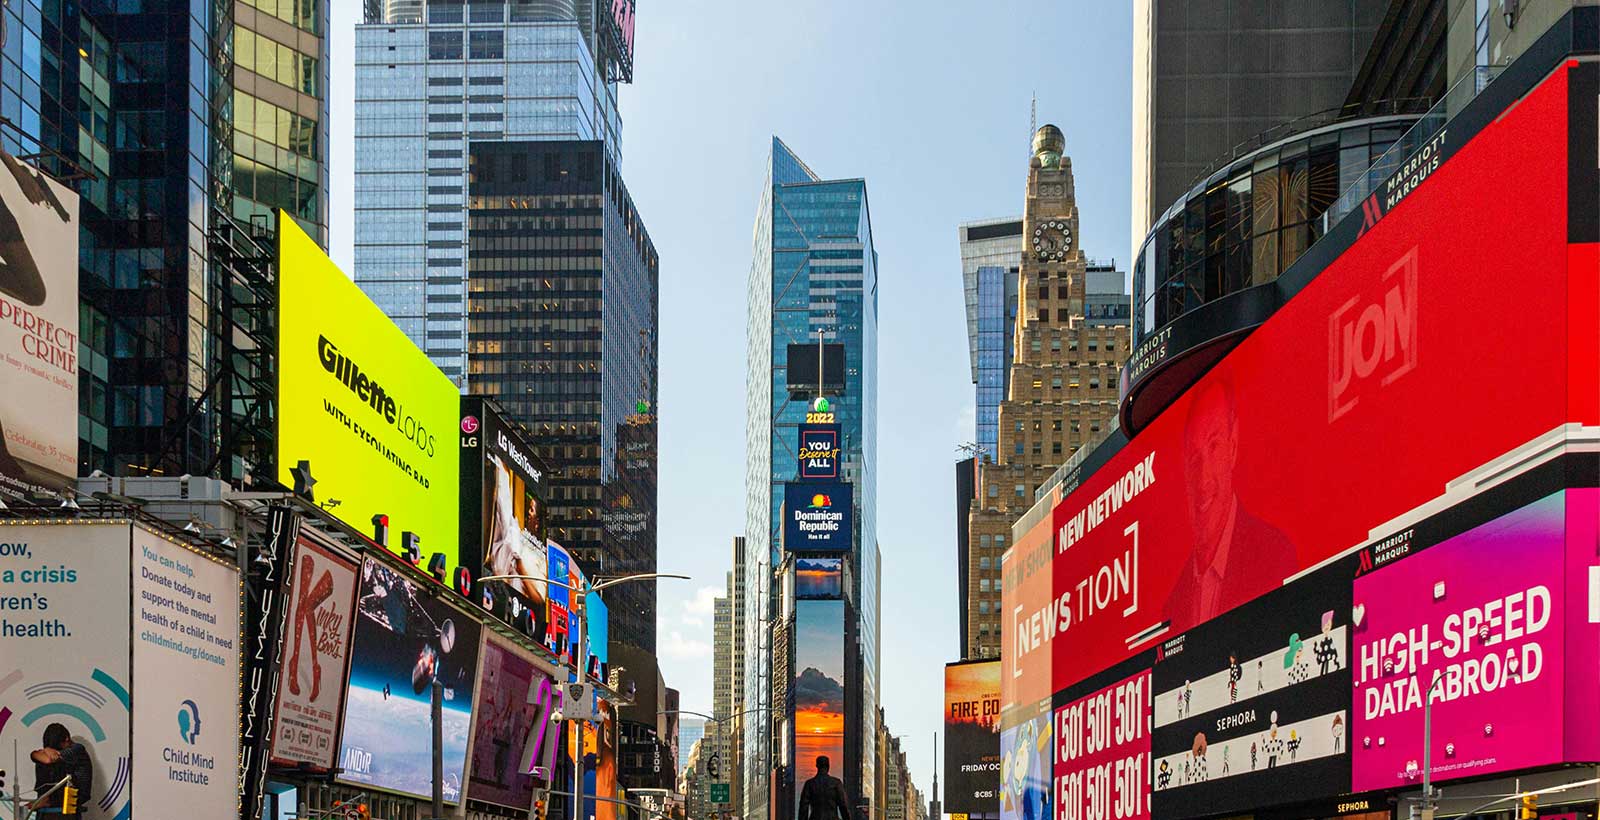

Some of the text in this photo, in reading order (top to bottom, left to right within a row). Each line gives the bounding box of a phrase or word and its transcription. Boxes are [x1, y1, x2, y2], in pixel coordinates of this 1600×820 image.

[1387, 129, 1447, 193] MARRIOTT
[1387, 156, 1438, 210] MARQUIS
[0, 298, 76, 353] PERFECT
[22, 334, 76, 374] CRIME
[1131, 327, 1172, 368] MARRIOTT
[1130, 346, 1165, 383] MARQUIS
[317, 334, 436, 458] Gillette Labs
[806, 413, 835, 424] 2022
[462, 437, 478, 447] LG
[498, 430, 507, 451] LG
[808, 441, 831, 450] YOU
[799, 448, 829, 460] Deserve
[808, 459, 831, 468] ALL
[1059, 451, 1156, 555] NEW NETWORK
[795, 510, 842, 521] Dominican
[799, 520, 839, 532] Republic
[1375, 529, 1414, 553] MARRIOTT
[142, 545, 195, 578] You can help.
[1375, 543, 1409, 565] MARQUIS
[3, 566, 77, 583] a crisis
[142, 566, 212, 603] Donate today and
[142, 590, 216, 625] support the mental
[3, 619, 71, 637] health.
[142, 609, 232, 649] health of a child in need
[1361, 585, 1551, 682] HIGH-SPEED
[141, 629, 226, 666] childmind.org/donate
[1365, 642, 1543, 720] DATA ABROAD
[951, 700, 978, 718] FIRE
[1216, 710, 1256, 731] SEPHORA
[163, 747, 214, 770] Child Mind
[961, 764, 987, 772] FRIDAY
[169, 767, 209, 786] Institute
[1338, 801, 1369, 813] SEPHORA
